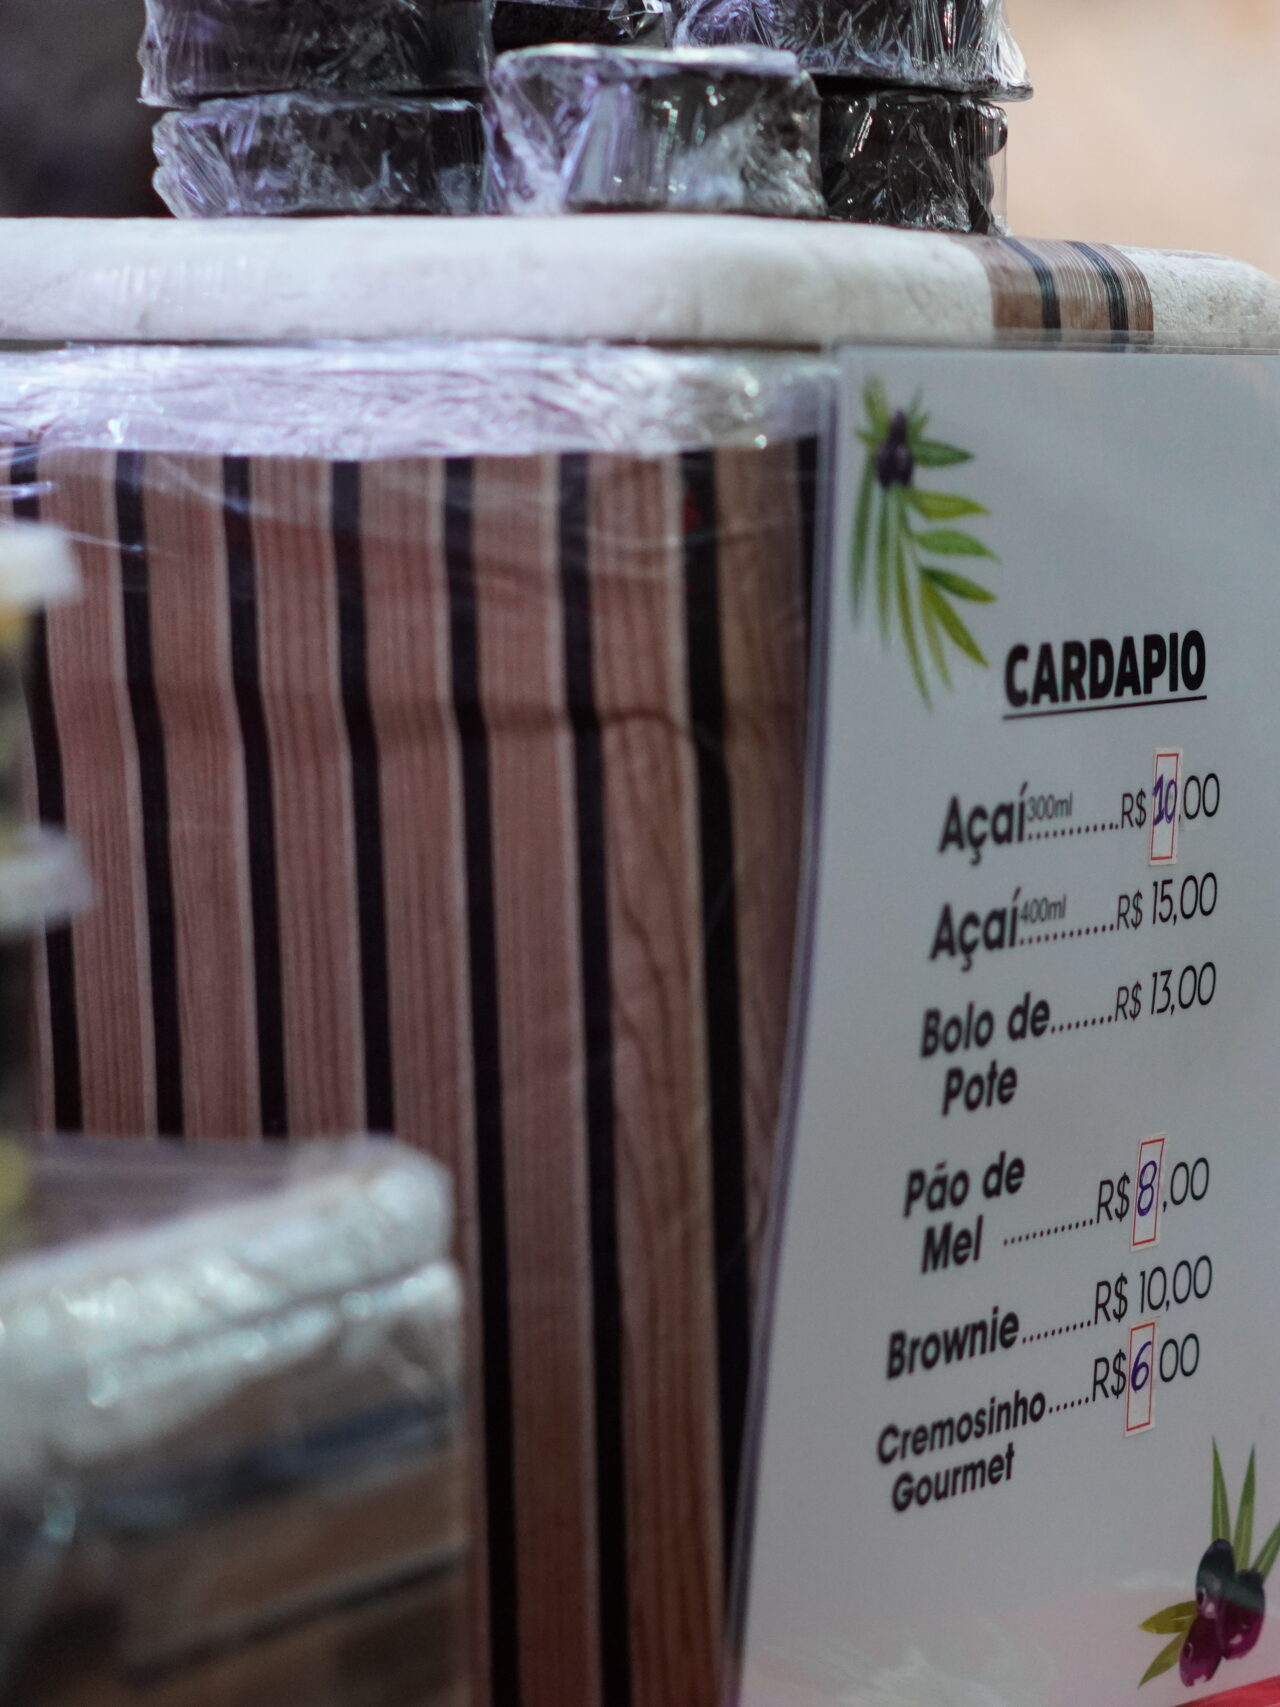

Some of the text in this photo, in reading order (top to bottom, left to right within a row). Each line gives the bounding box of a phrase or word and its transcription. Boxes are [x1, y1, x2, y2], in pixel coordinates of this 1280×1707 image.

[1004, 629, 1206, 708] CARDAPIO
[938, 780, 1029, 866] Açaí
[1026, 793, 1073, 821] 300ml
[1120, 789, 1147, 829] R$
[929, 871, 1217, 973] Açaí 400ml R$ 15,00
[920, 1002, 995, 1060] Bolo
[1114, 980, 1143, 1022] R$
[1150, 961, 1216, 1016] 13,00
[941, 1058, 1018, 1117] Pote
[902, 1150, 1026, 1218] Pão de
[920, 1213, 985, 1276] Mel
[1096, 1171, 1131, 1223] R$
[886, 1254, 1213, 1381] Brownie R$ 10,00
[876, 1388, 1047, 1467] Cremosinho
[1092, 1348, 1127, 1401] R$
[891, 1441, 1015, 1514] Gourmet
